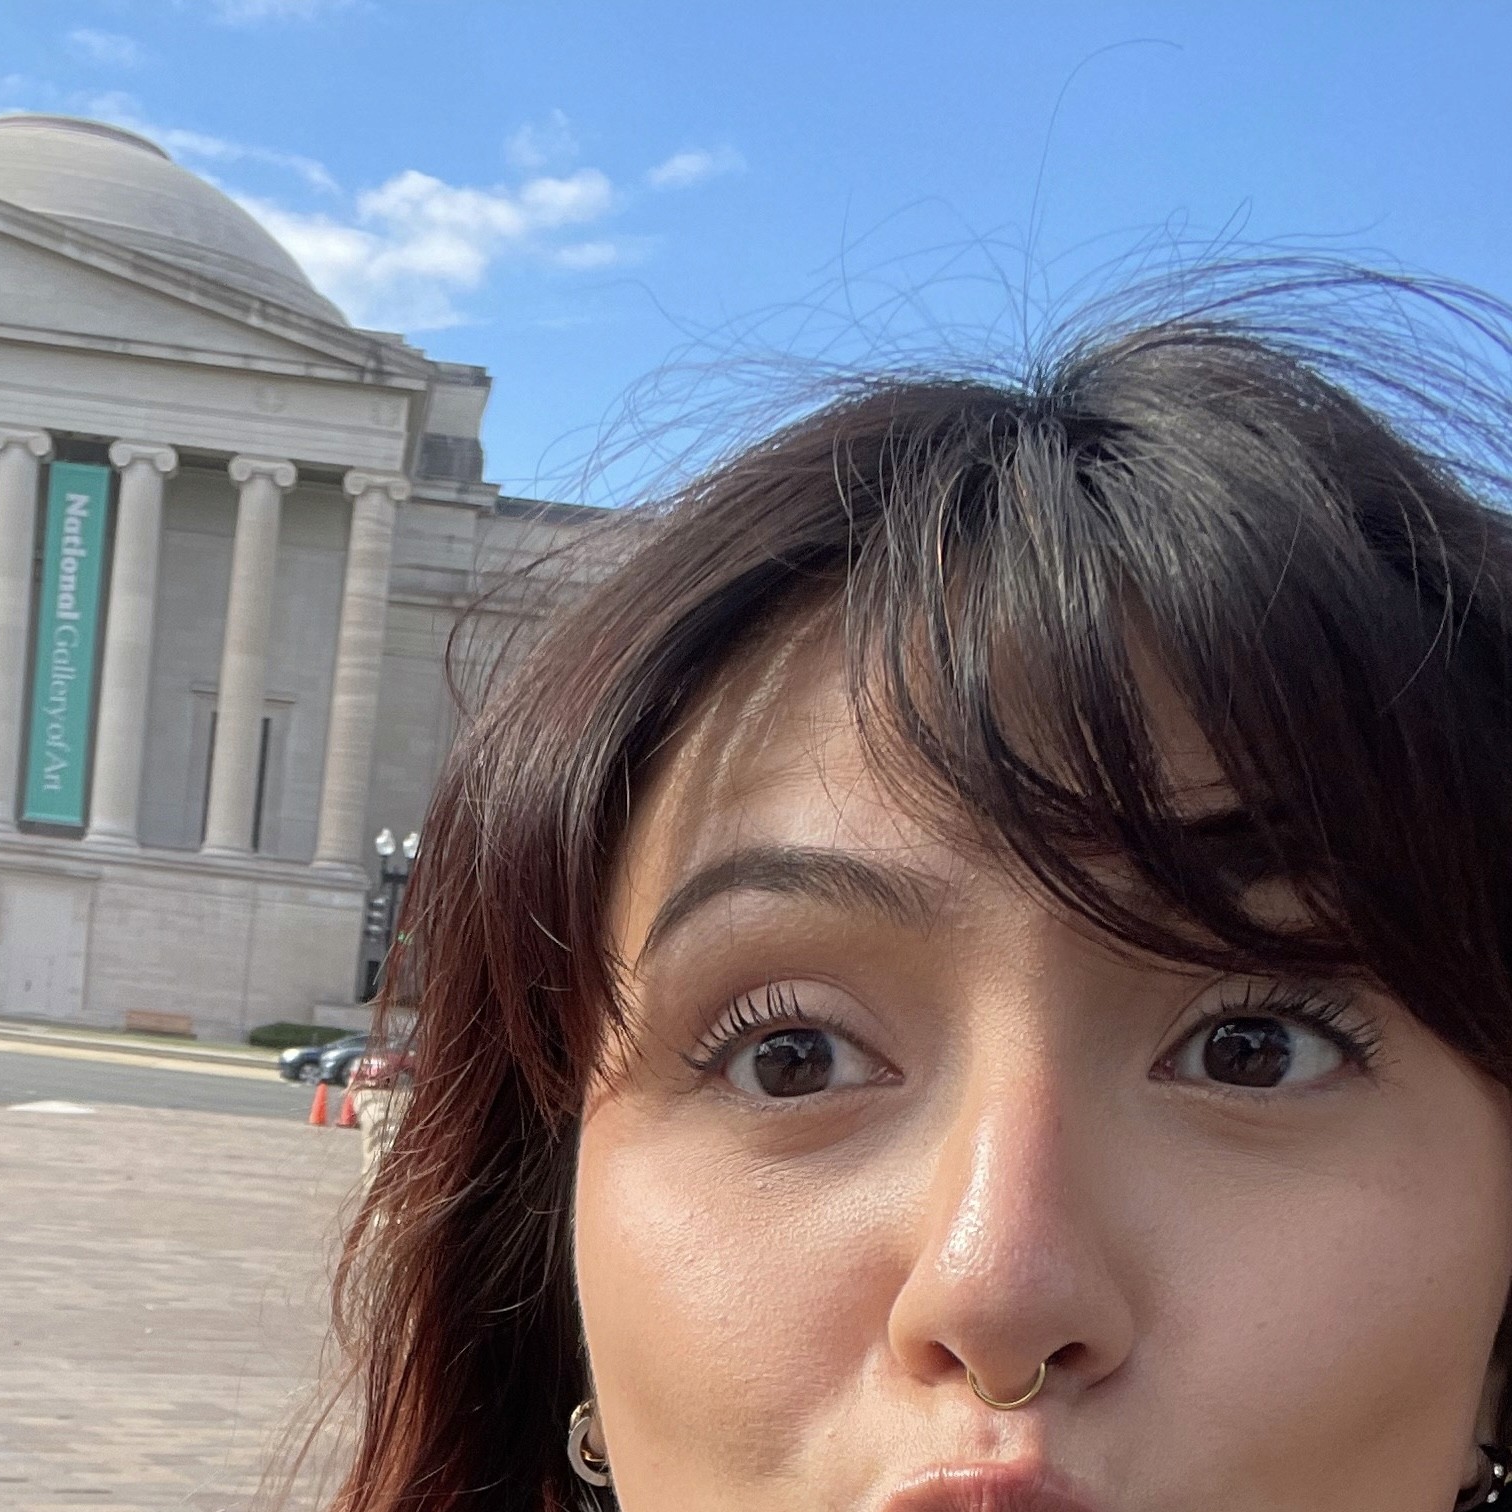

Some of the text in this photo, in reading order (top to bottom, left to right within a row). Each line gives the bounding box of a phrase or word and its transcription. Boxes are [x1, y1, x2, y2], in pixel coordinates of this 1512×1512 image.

[42, 493, 90, 791] National Gallery of Art
